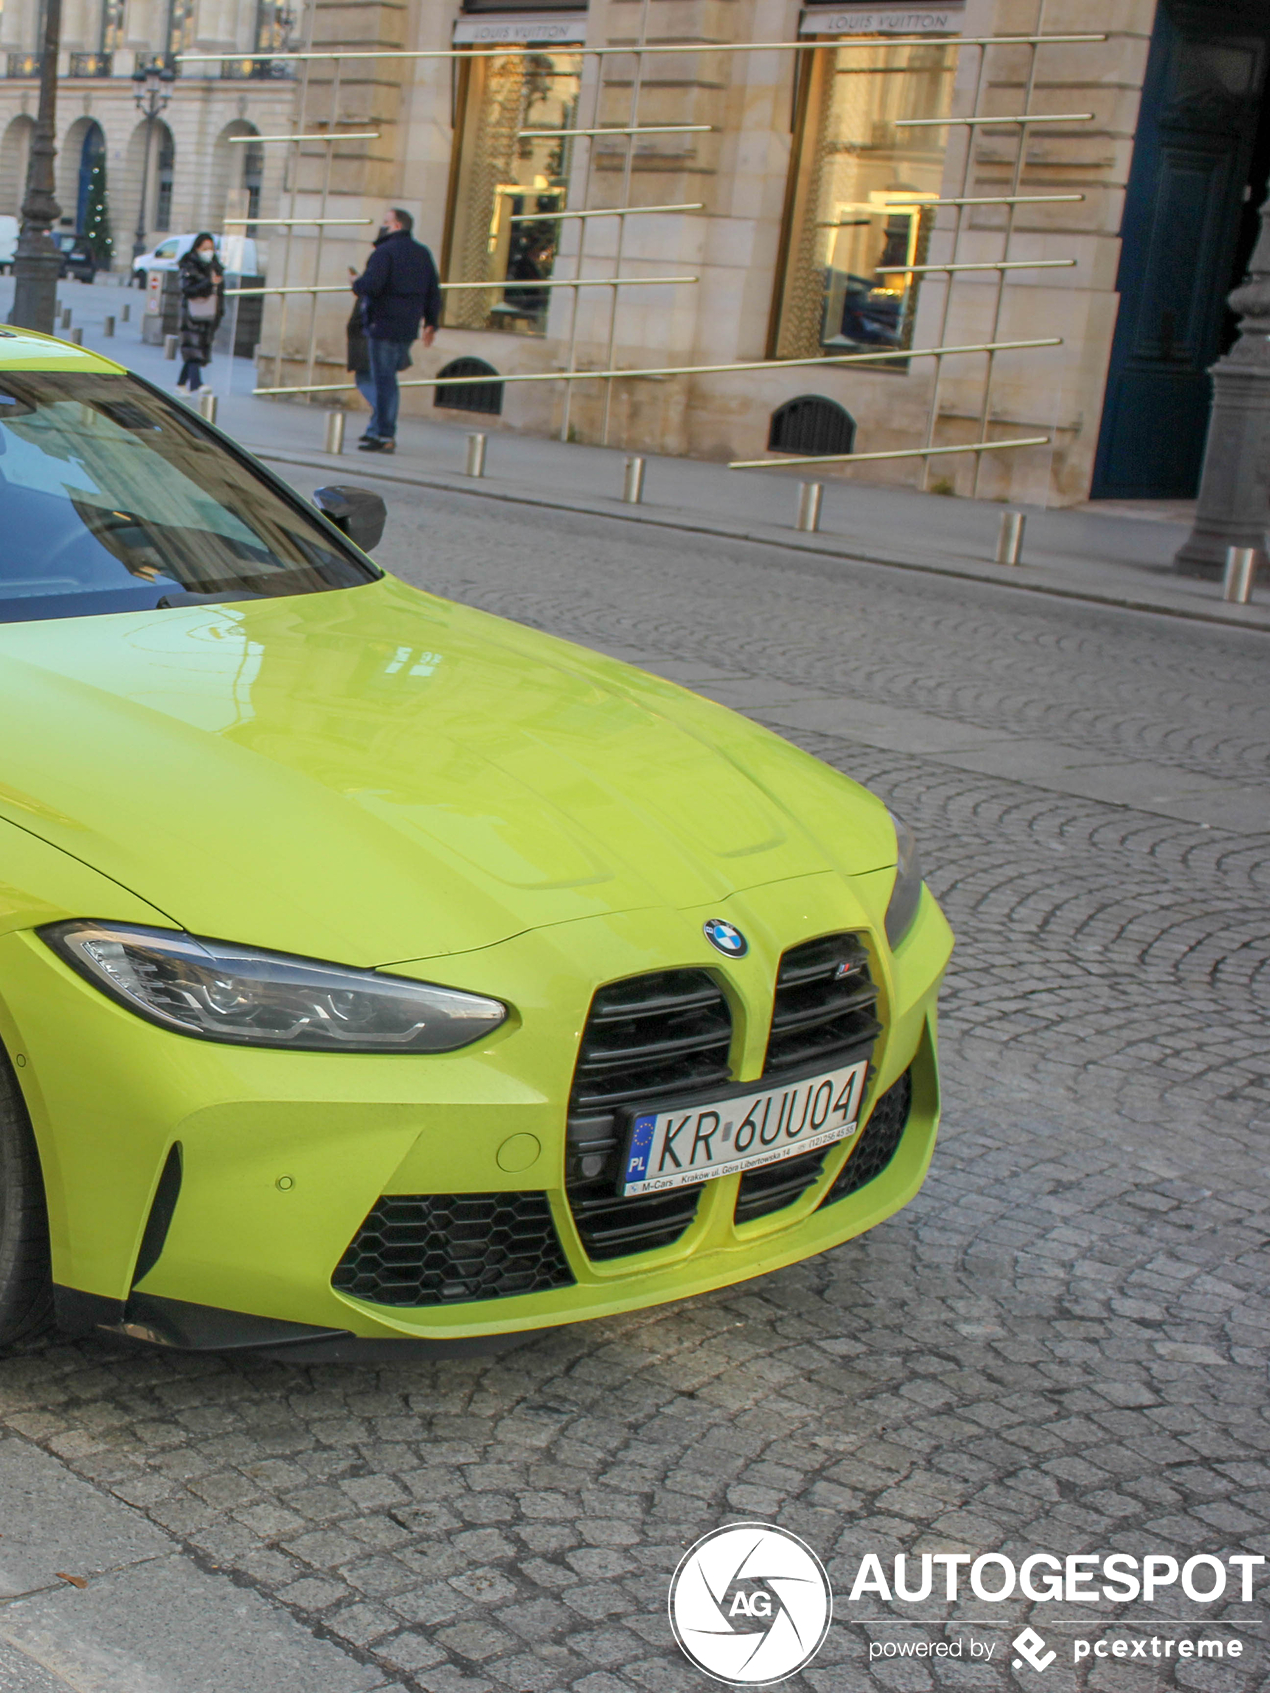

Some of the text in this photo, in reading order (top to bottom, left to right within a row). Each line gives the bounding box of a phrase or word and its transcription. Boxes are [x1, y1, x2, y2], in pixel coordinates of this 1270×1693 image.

[828, 14, 948, 29] LOUIS VUITTON
[474, 25, 570, 38] LOUIS VUITTON
[658, 1071, 857, 1171] KR 6UU04
[629, 1157, 645, 1173] PL
[642, 1179, 674, 1191] M-Cars
[782, 1148, 791, 1157] 14
